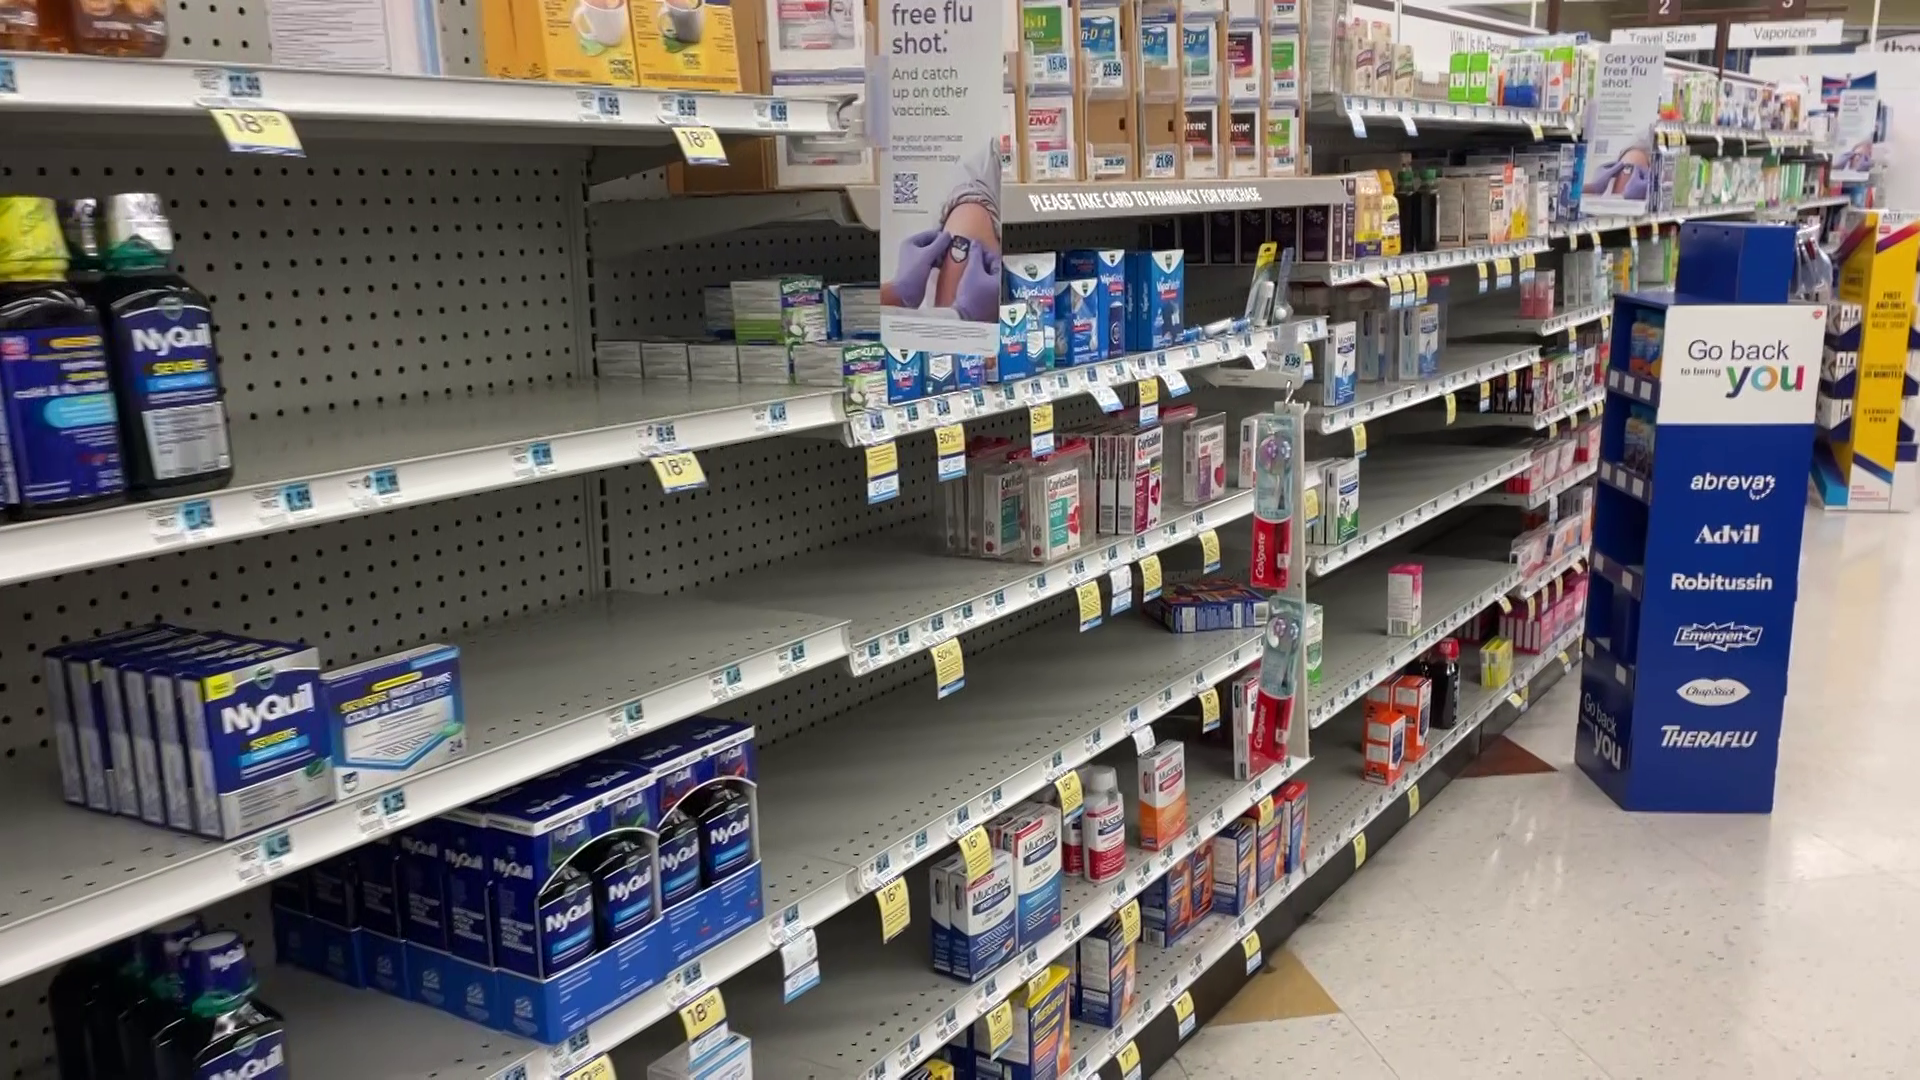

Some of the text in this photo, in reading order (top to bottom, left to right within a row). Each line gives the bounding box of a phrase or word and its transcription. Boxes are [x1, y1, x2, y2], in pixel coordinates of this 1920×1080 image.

[892, 0, 972, 26] free flu
[1658, 0, 1670, 14] 2
[892, 30, 948, 54] shot.
[1630, 31, 1697, 44] Travel Sizes
[1753, 25, 1817, 41] Vaporizers
[1605, 53, 1658, 66] Get your
[892, 66, 958, 80] And catch
[1603, 65, 1647, 77] free flu
[893, 85, 968, 100] up on other
[1602, 78, 1632, 88] shot.
[892, 102, 950, 116] vaccines.
[1028, 187, 1262, 212] PLEASE TAKE CARD TO PHARMACY FOR PURCHASE
[131, 323, 212, 356] NyQuil
[1688, 339, 1789, 361] Go back
[1284, 354, 1300, 368] 9.99
[1681, 365, 1805, 398] to being you
[1691, 472, 1768, 491] abreva
[1695, 525, 1760, 544] Advil
[1255, 531, 1266, 578] Colgate
[1671, 573, 1773, 590] Robitussin
[1681, 628, 1756, 645] Emergen-C
[1685, 685, 1737, 698] ChapStick
[221, 682, 315, 736] NyQuil
[1584, 693, 1595, 716] Go
[1597, 703, 1616, 738] back
[1254, 705, 1267, 748] Colgate
[1661, 725, 1758, 748] THERAFLU
[450, 739, 464, 753] 24
[1593, 724, 1622, 770] you
[710, 813, 750, 845] NyQuil
[660, 837, 699, 871] NyQuil
[608, 865, 652, 902] NyQuil
[972, 875, 1010, 901] Mucinex
[545, 895, 593, 932] NyQuil
